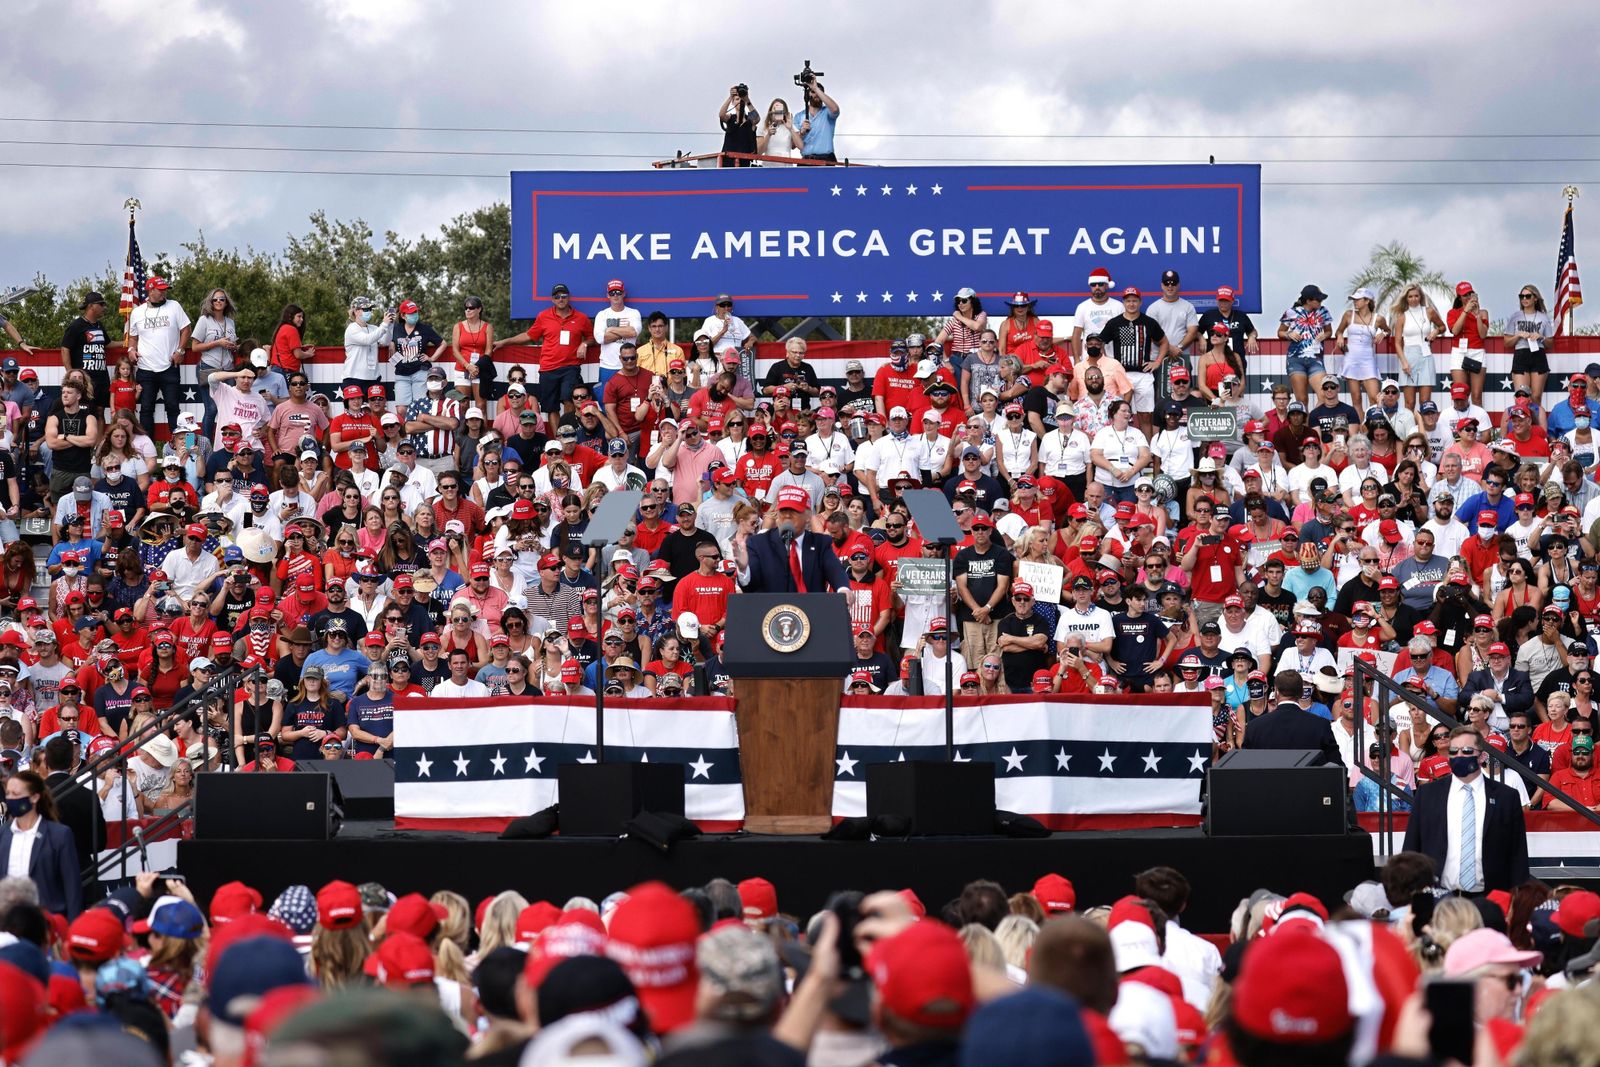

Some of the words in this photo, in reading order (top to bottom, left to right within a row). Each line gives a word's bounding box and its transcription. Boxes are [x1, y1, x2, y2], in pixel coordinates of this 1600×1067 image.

[552, 232, 671, 260] MAKE
[691, 229, 890, 259] AMERICA
[909, 227, 1050, 256] GREAT
[1068, 225, 1222, 256] AGAIN!
[1517, 320, 1542, 333] TRUMP
[234, 407, 258, 420] TRUMP
[1194, 418, 1232, 427] VETERANS
[746, 468, 772, 476] Trump
[968, 560, 994, 573] TRUMP
[906, 570, 946, 580] VETERANS
[1024, 574, 1054, 585] LOVES
[1035, 585, 1056, 596] LANIA
[1068, 624, 1100, 632] TRUMP
[36, 678, 59, 687] Trump
